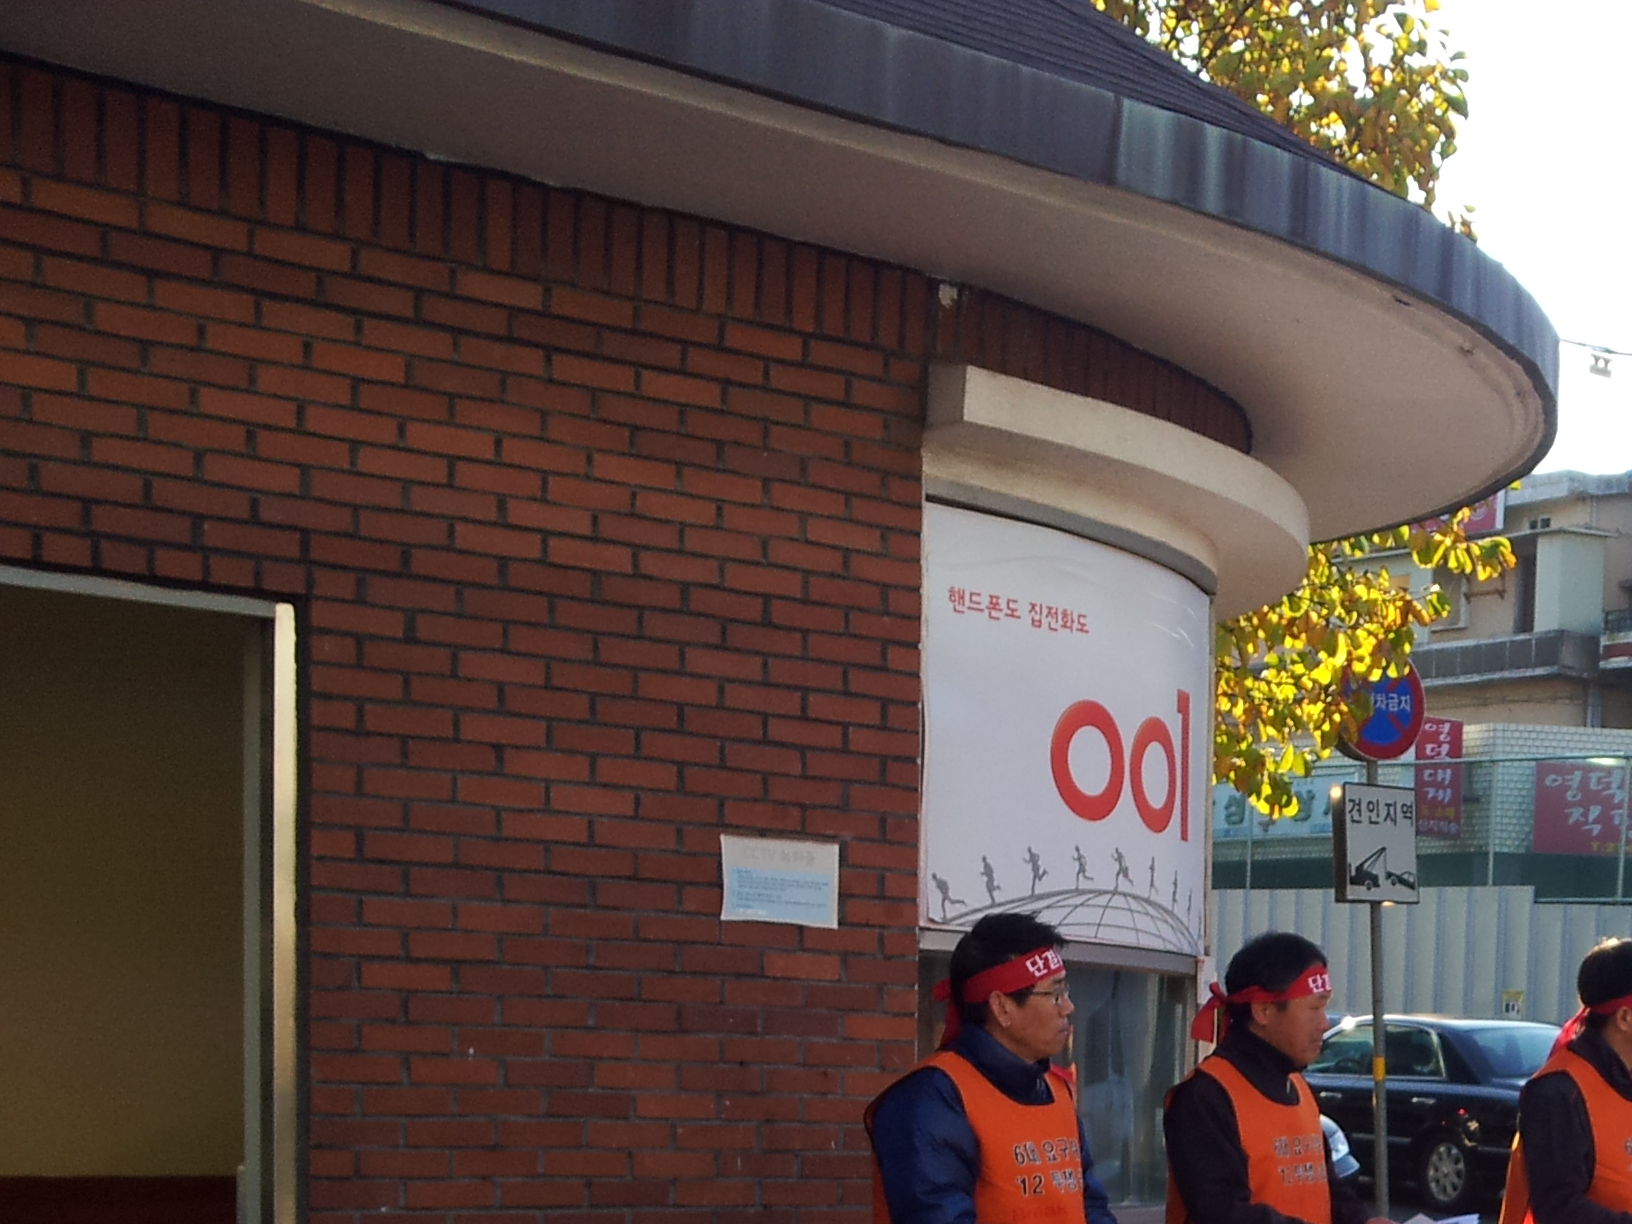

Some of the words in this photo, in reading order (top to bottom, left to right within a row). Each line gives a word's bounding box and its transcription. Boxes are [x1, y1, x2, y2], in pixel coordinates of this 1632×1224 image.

[948, 585, 1022, 622] 핸드폰도
[1028, 601, 1090, 634] 집전화도
[1049, 688, 1191, 843] 001
[1347, 798, 1414, 828] 견인지역
